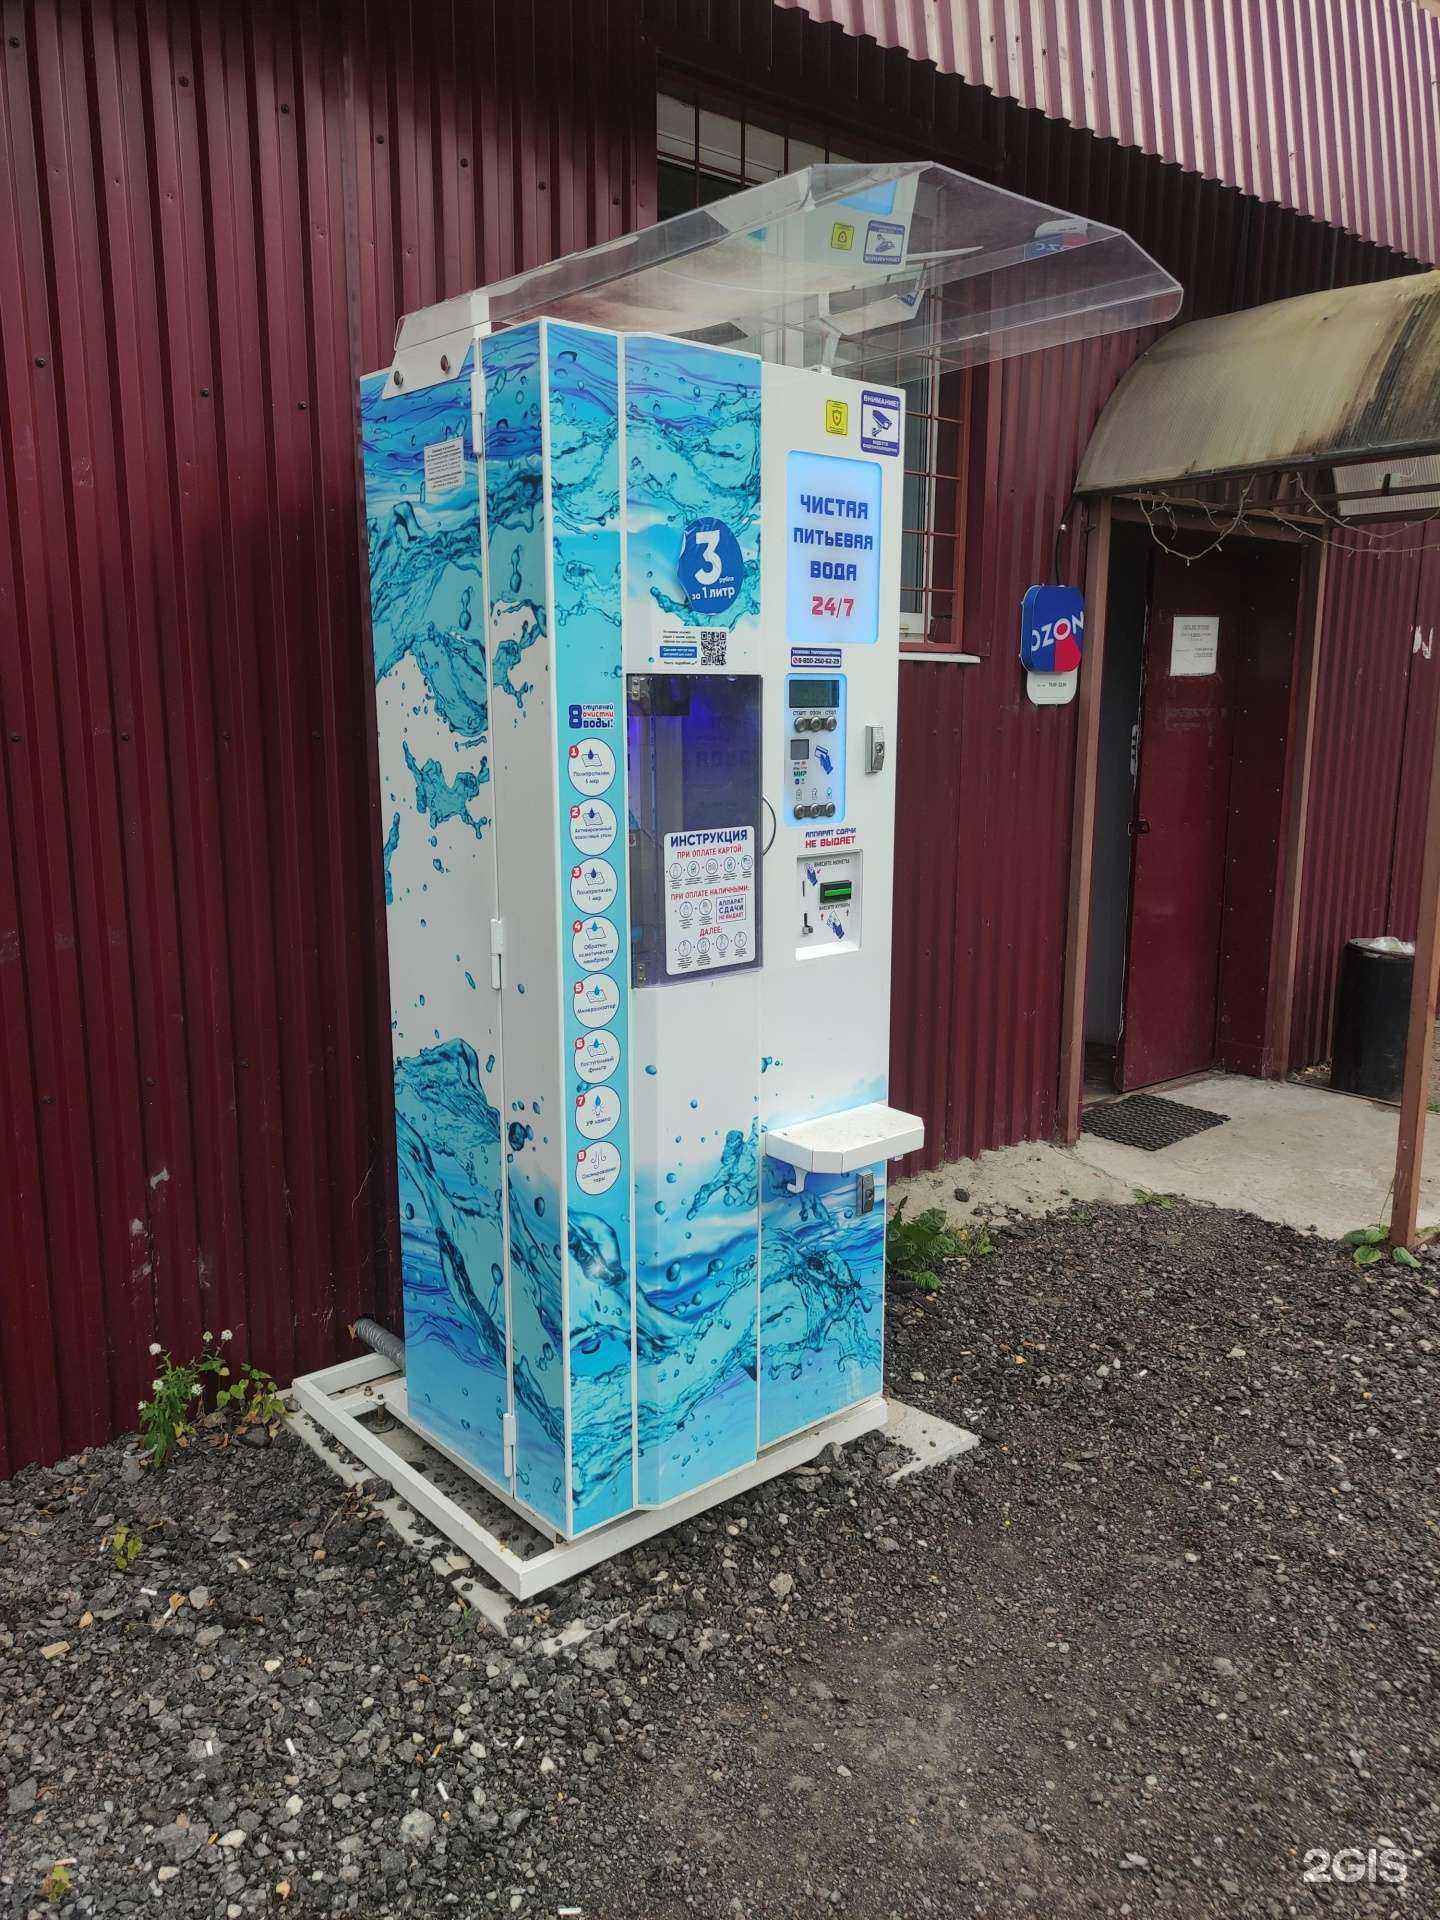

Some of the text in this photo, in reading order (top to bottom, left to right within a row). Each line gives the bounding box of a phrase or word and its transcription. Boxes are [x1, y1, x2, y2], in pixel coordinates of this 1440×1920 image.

[800, 494, 868, 519] ЧИСТАЯ
[793, 527, 873, 550] ПИТЬЕВАЯ
[694, 529, 722, 585] 3
[810, 560, 857, 581] ВОДА
[702, 586, 708, 599] 1
[709, 586, 735, 599] литр
[811, 596, 854, 618] 24/7
[1031, 611, 1084, 652] OZON
[568, 705, 583, 729] 8
[583, 718, 615, 728] воды:
[671, 830, 747, 847] ИНСТРУКЦИЯ
[805, 827, 857, 838] АППАРАТ СДАЧИ
[805, 836, 856, 848] НЕ ВЫДАЕТ
[677, 850, 690, 859] ПРИ
[692, 848, 717, 857] ОПЛАТЕ
[671, 892, 684, 900] ПРИ
[686, 890, 708, 899] ОПЛАТЕ
[718, 898, 744, 906] АППАРАТ
[718, 905, 744, 914] СДАЧИ
